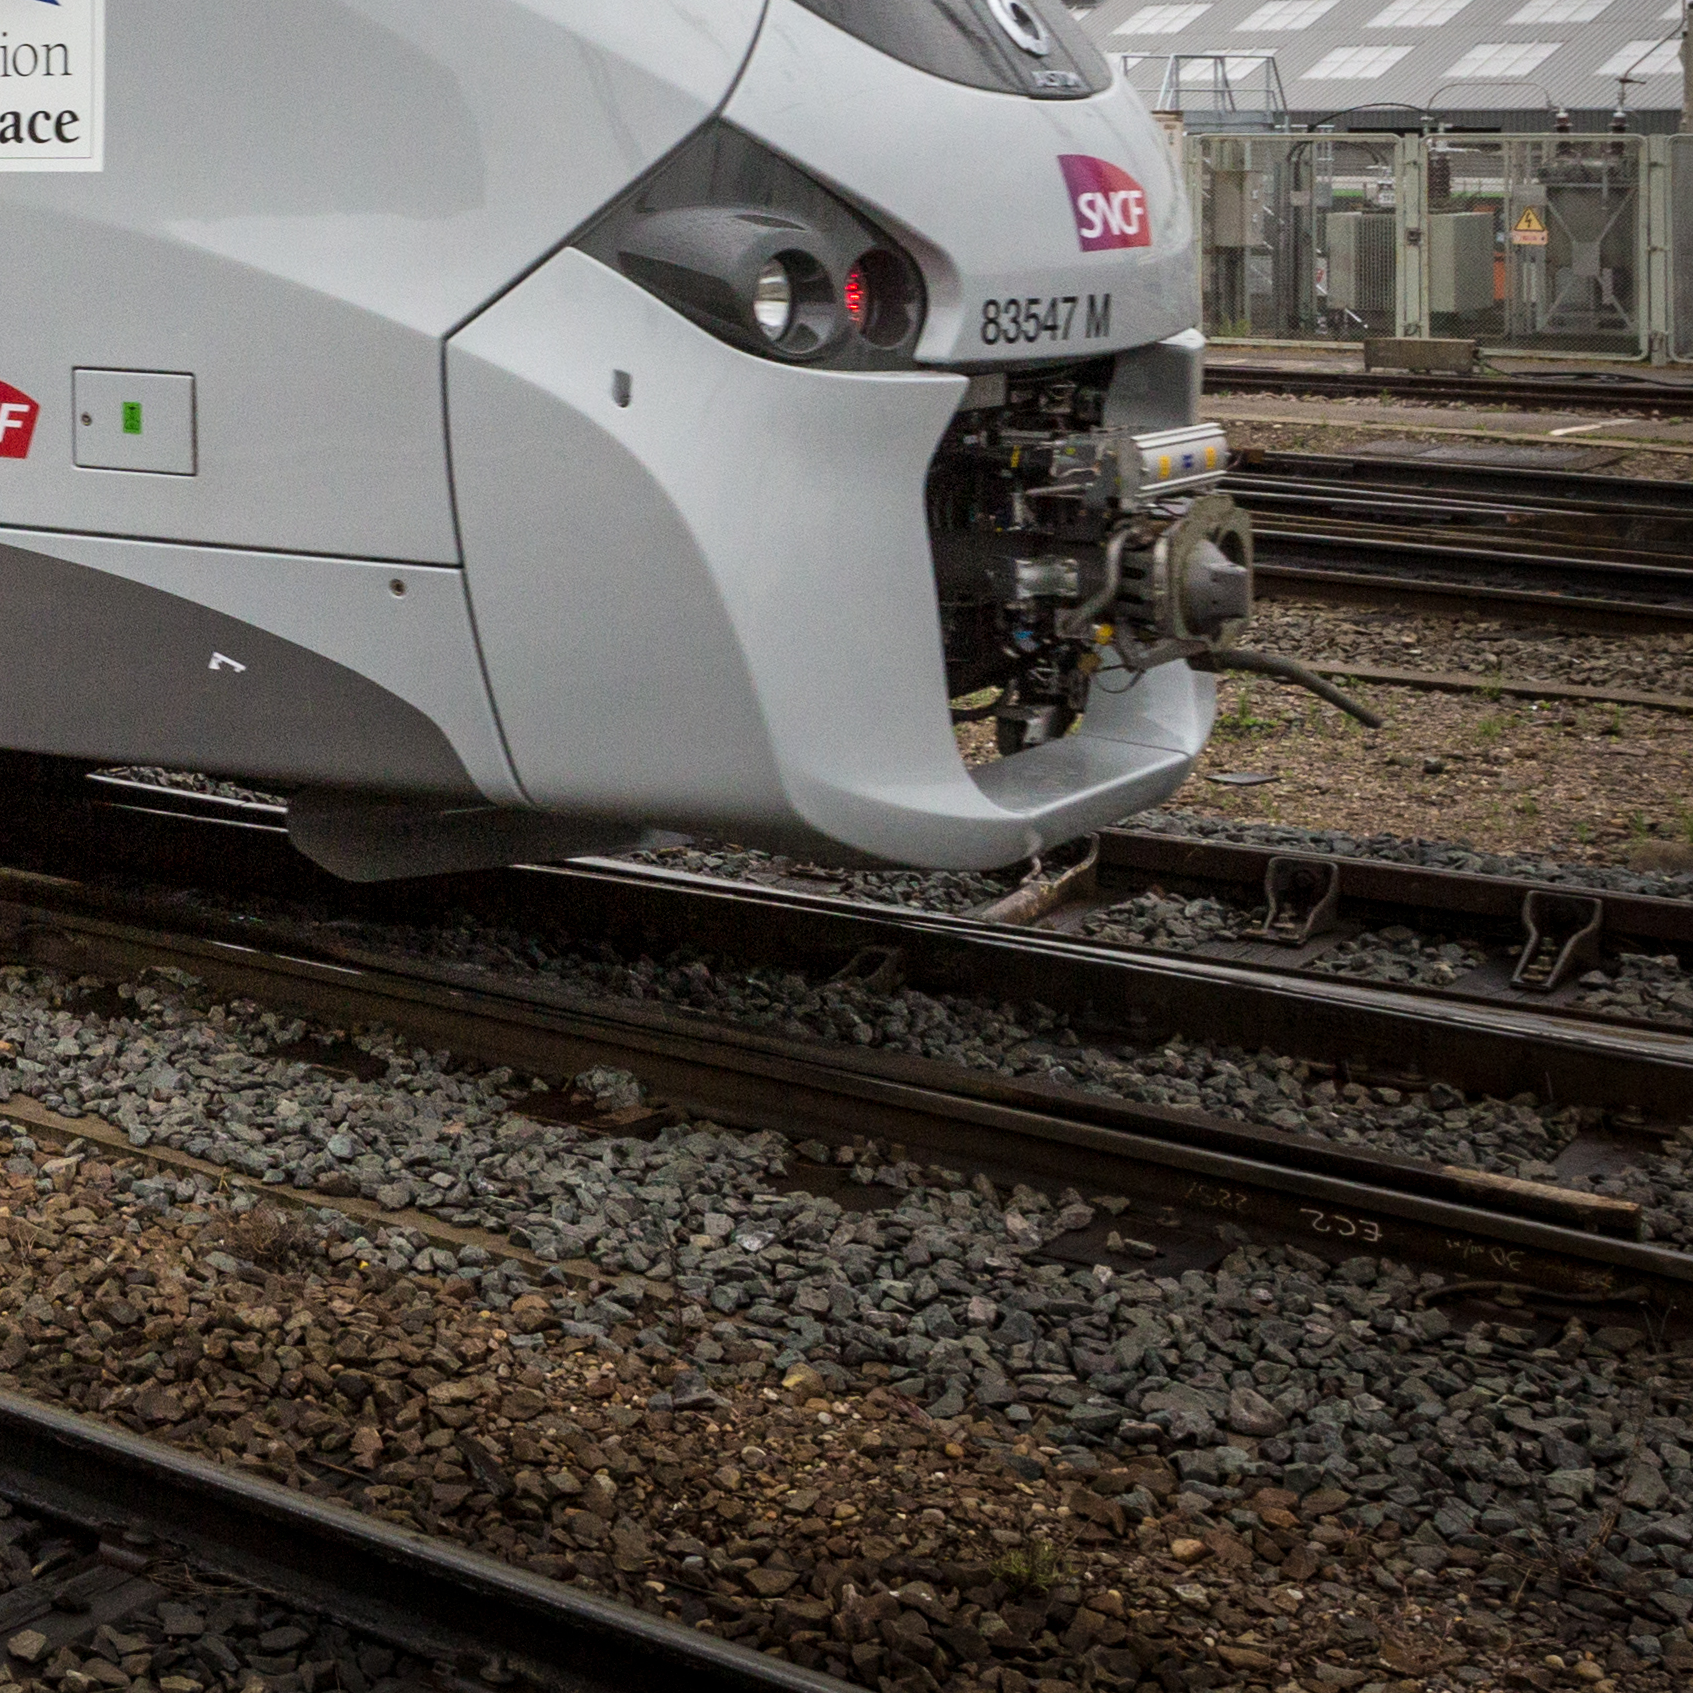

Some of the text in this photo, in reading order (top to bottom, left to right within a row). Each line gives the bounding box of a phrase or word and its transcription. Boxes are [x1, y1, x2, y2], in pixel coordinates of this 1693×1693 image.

[1077, 190, 1144, 239] SNCF
[980, 293, 1112, 345] 83547 M
[1300, 1208, 1383, 1243] EC2
